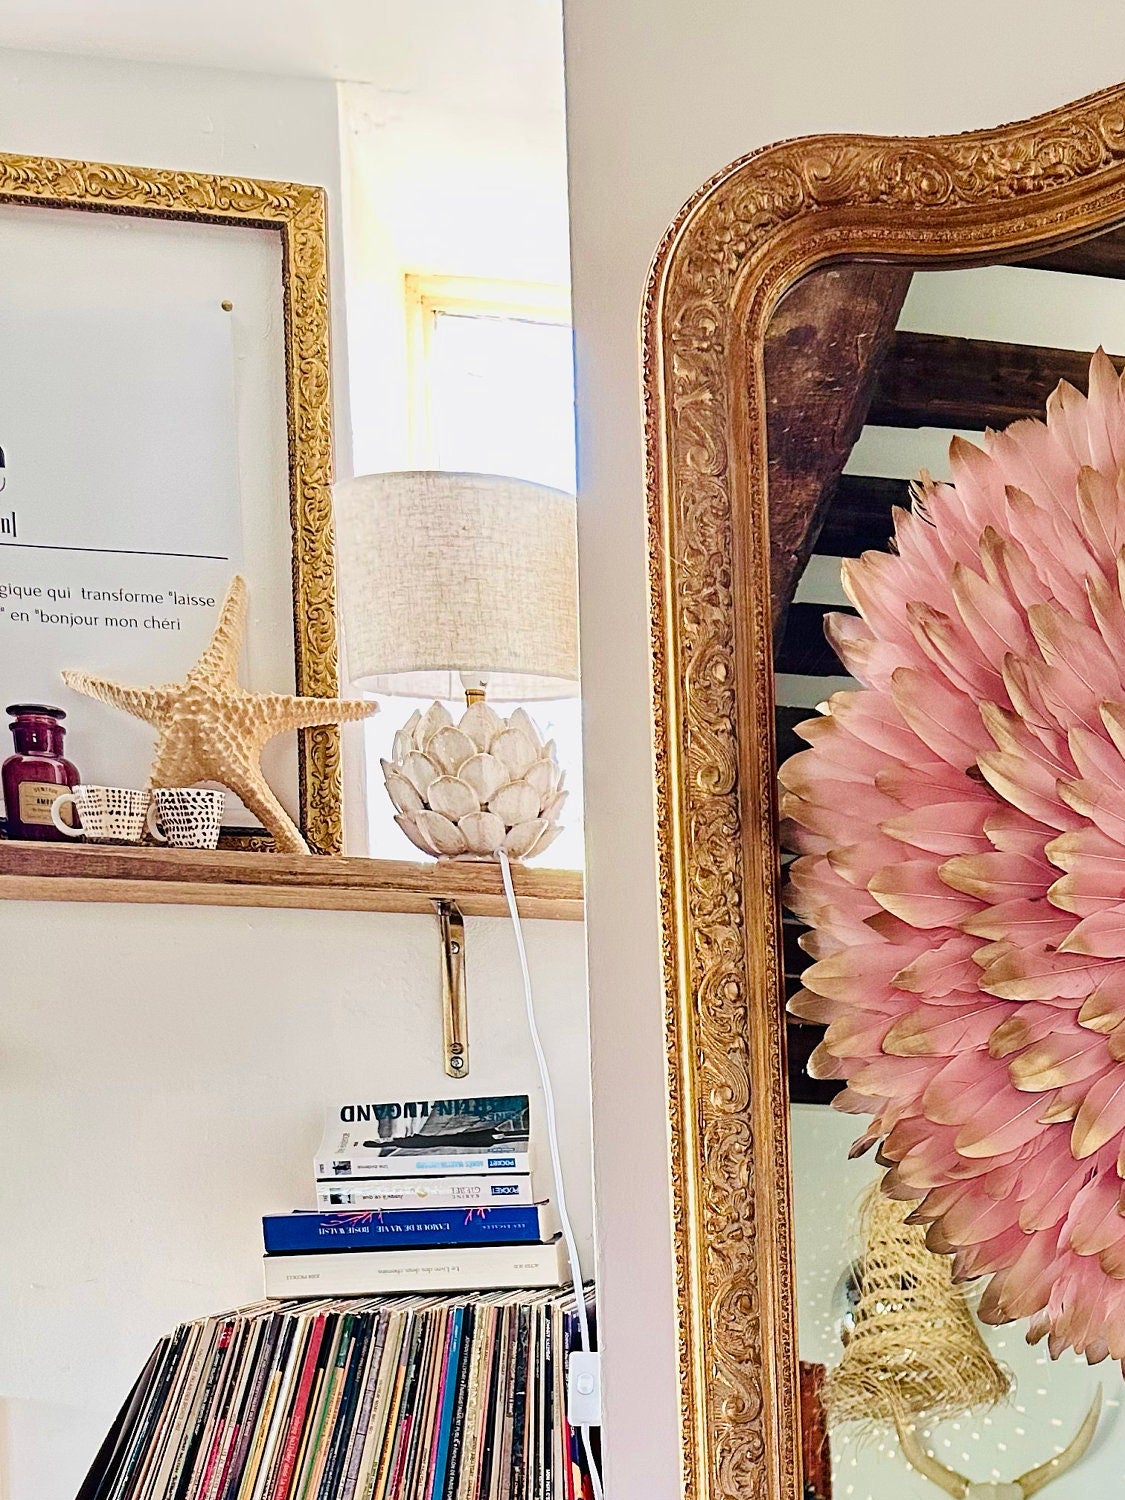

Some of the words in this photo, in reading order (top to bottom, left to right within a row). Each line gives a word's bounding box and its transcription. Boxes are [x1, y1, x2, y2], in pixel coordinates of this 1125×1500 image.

[47, 586, 71, 602] qui
[81, 587, 164, 604] transforme
[10, 610, 30, 623] en
[105, 615, 138, 629] mon
[143, 615, 181, 631] chéri
[404, 1224, 415, 1232] DE
